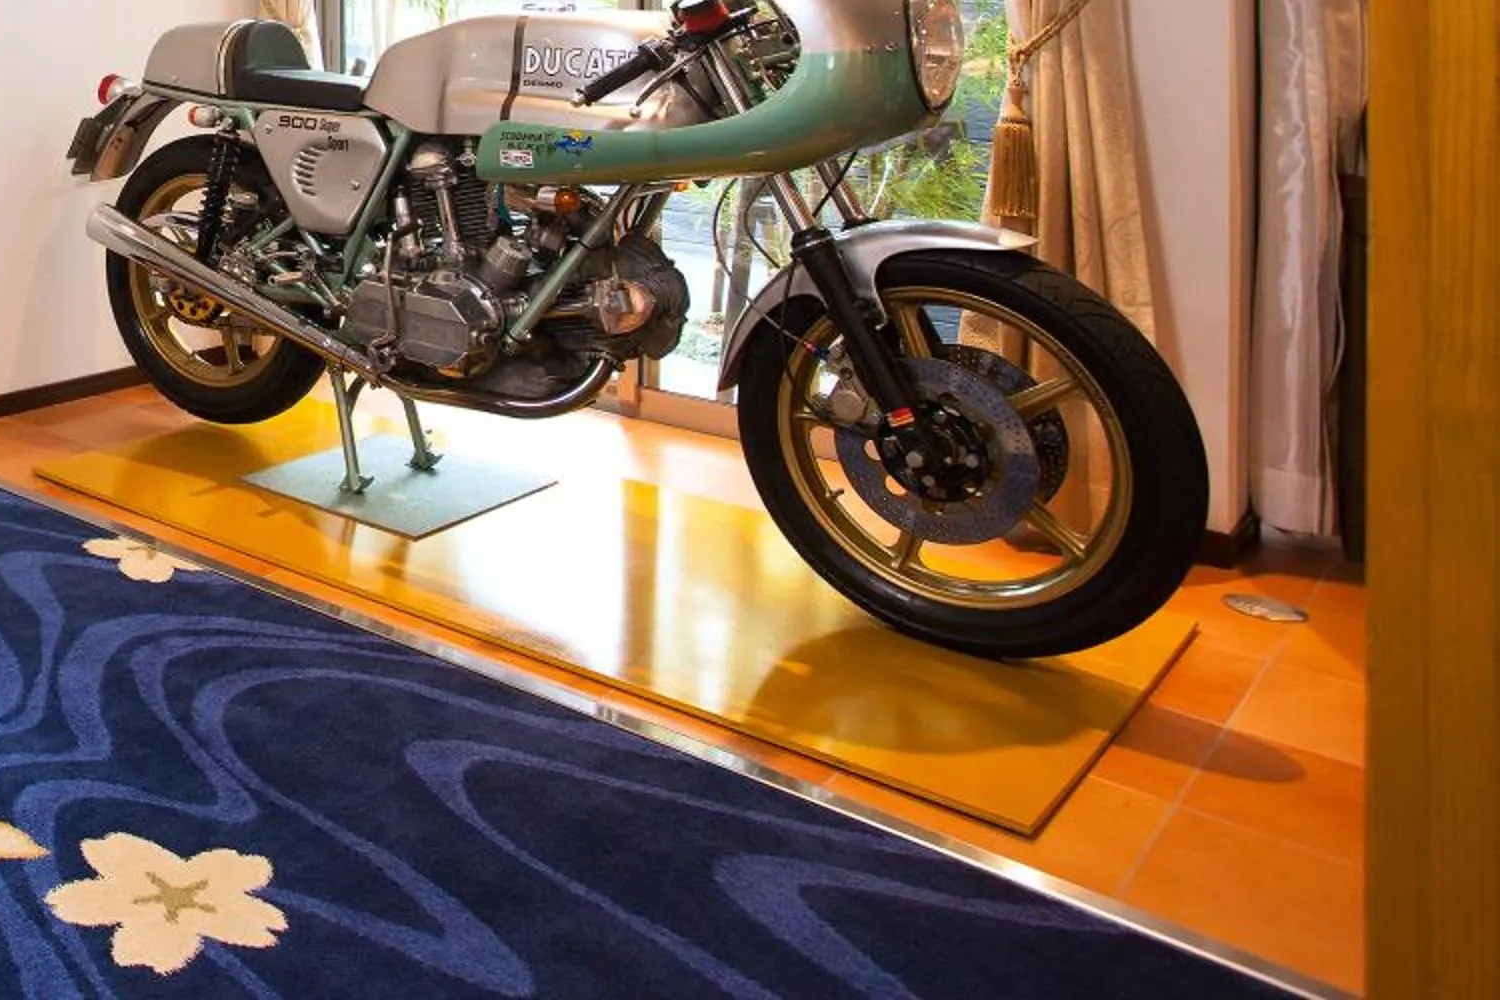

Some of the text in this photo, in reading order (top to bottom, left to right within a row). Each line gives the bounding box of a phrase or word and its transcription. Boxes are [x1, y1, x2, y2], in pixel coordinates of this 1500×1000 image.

[523, 45, 641, 78] DUCAT
[522, 79, 563, 89] DESMO
[278, 115, 318, 131] 900
